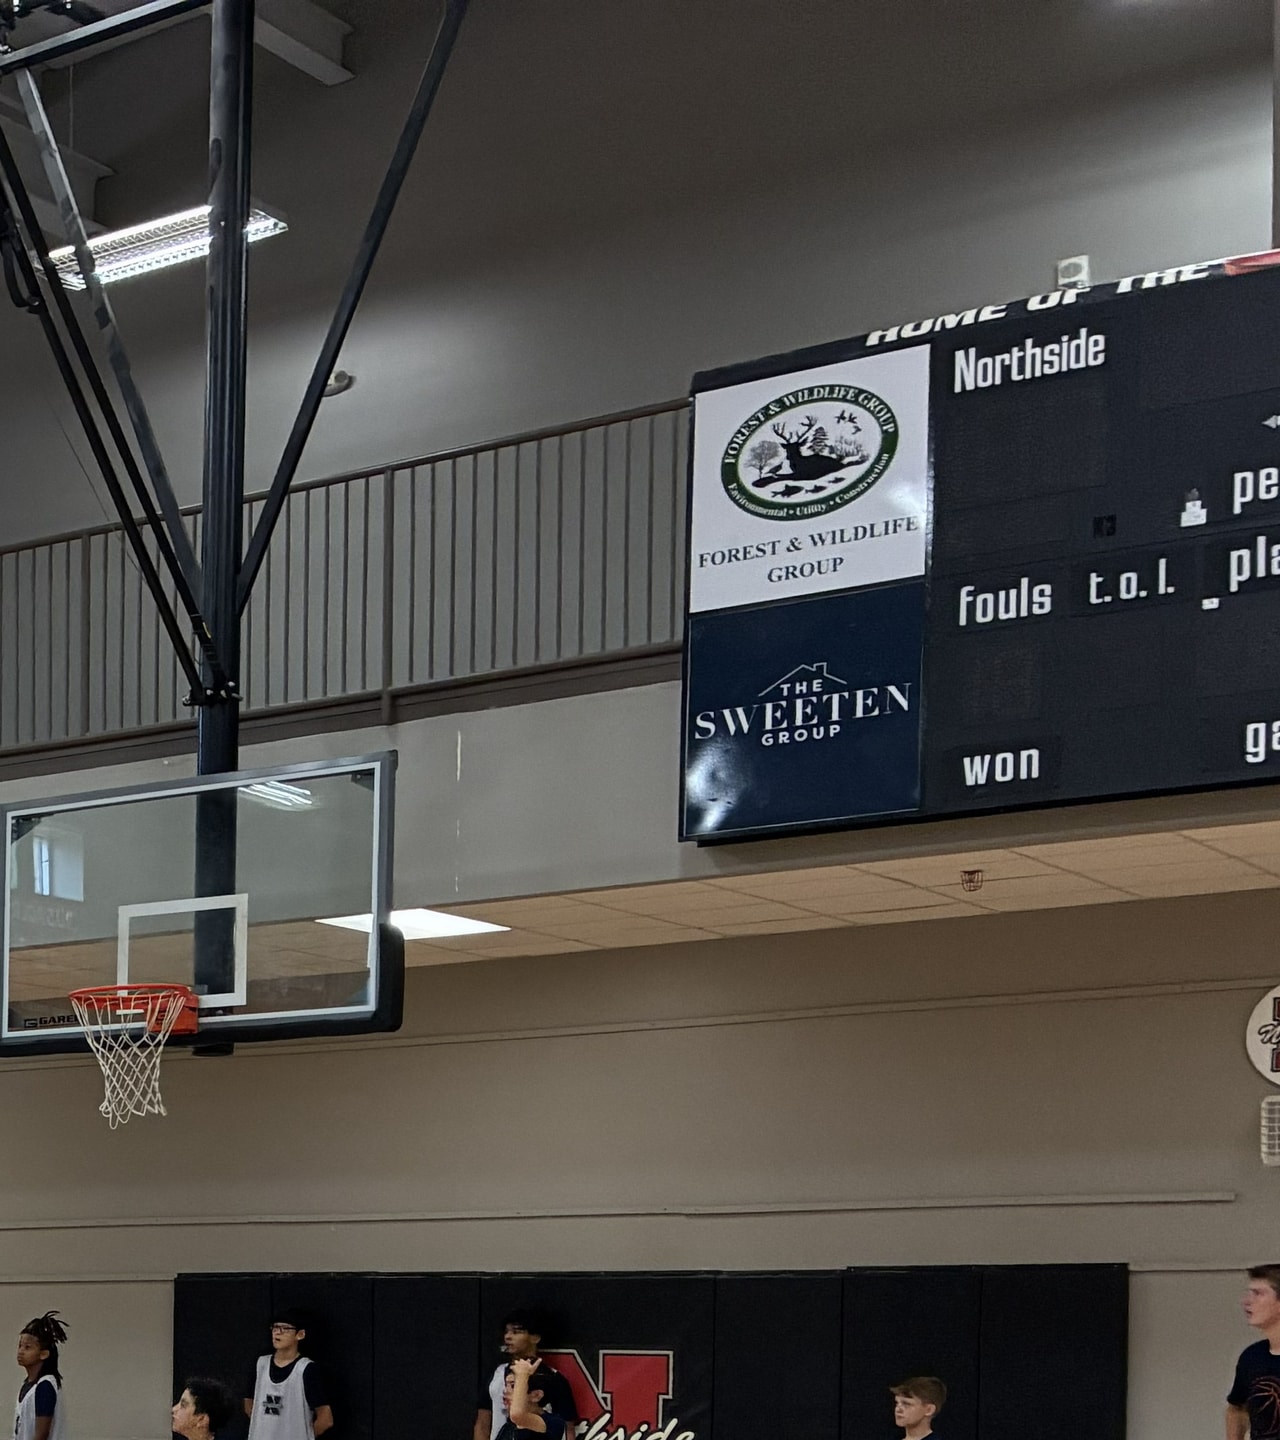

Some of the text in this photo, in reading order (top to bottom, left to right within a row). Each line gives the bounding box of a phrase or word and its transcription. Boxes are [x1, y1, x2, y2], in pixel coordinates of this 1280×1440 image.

[865, 264, 1209, 346] HOME OF THE
[953, 328, 1107, 394] Northside
[724, 386, 896, 464] FOREST & WILDLIFE GROUP
[727, 452, 890, 517] Environmental Utility Construction
[698, 515, 919, 569] FOREST & WILDLIFE
[767, 556, 845, 583] GROUP
[958, 576, 1053, 626] fouls
[694, 682, 912, 741] SWEETEN
[780, 678, 824, 695] THE
[761, 724, 842, 746] GROUP
[963, 748, 1040, 786] won
